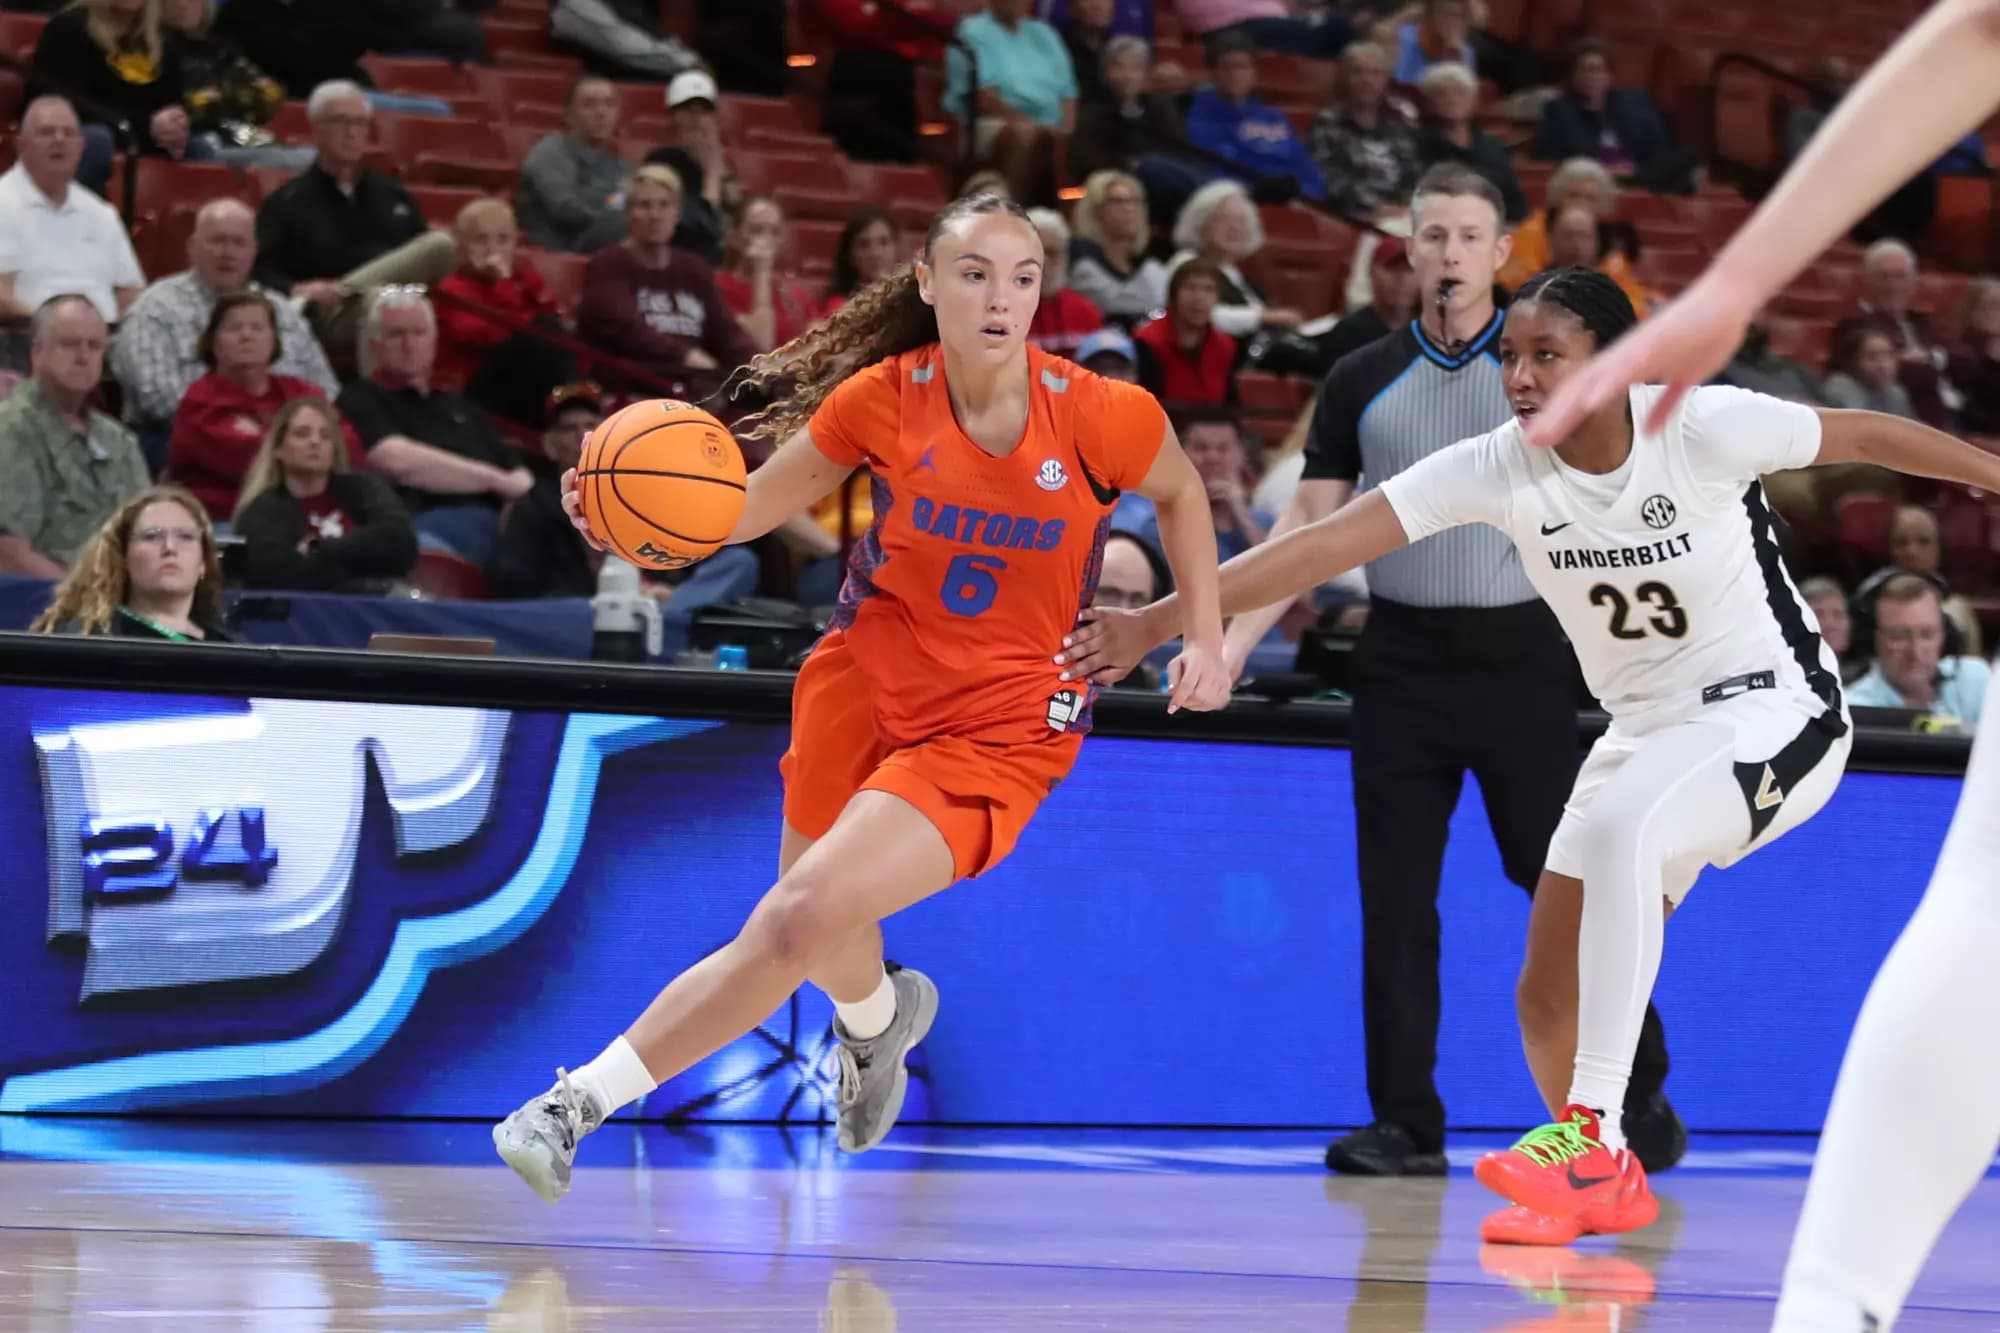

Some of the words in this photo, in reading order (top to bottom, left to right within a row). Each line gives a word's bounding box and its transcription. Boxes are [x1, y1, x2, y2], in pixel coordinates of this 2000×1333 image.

[1041, 459, 1063, 482] SEC
[912, 496, 1066, 551] GATORS
[1642, 495, 1676, 529] SEC
[1548, 533, 1692, 570] VANDERBILT
[940, 554, 1007, 618] 6
[1588, 580, 1688, 640] 23
[80, 807, 278, 901] 24
